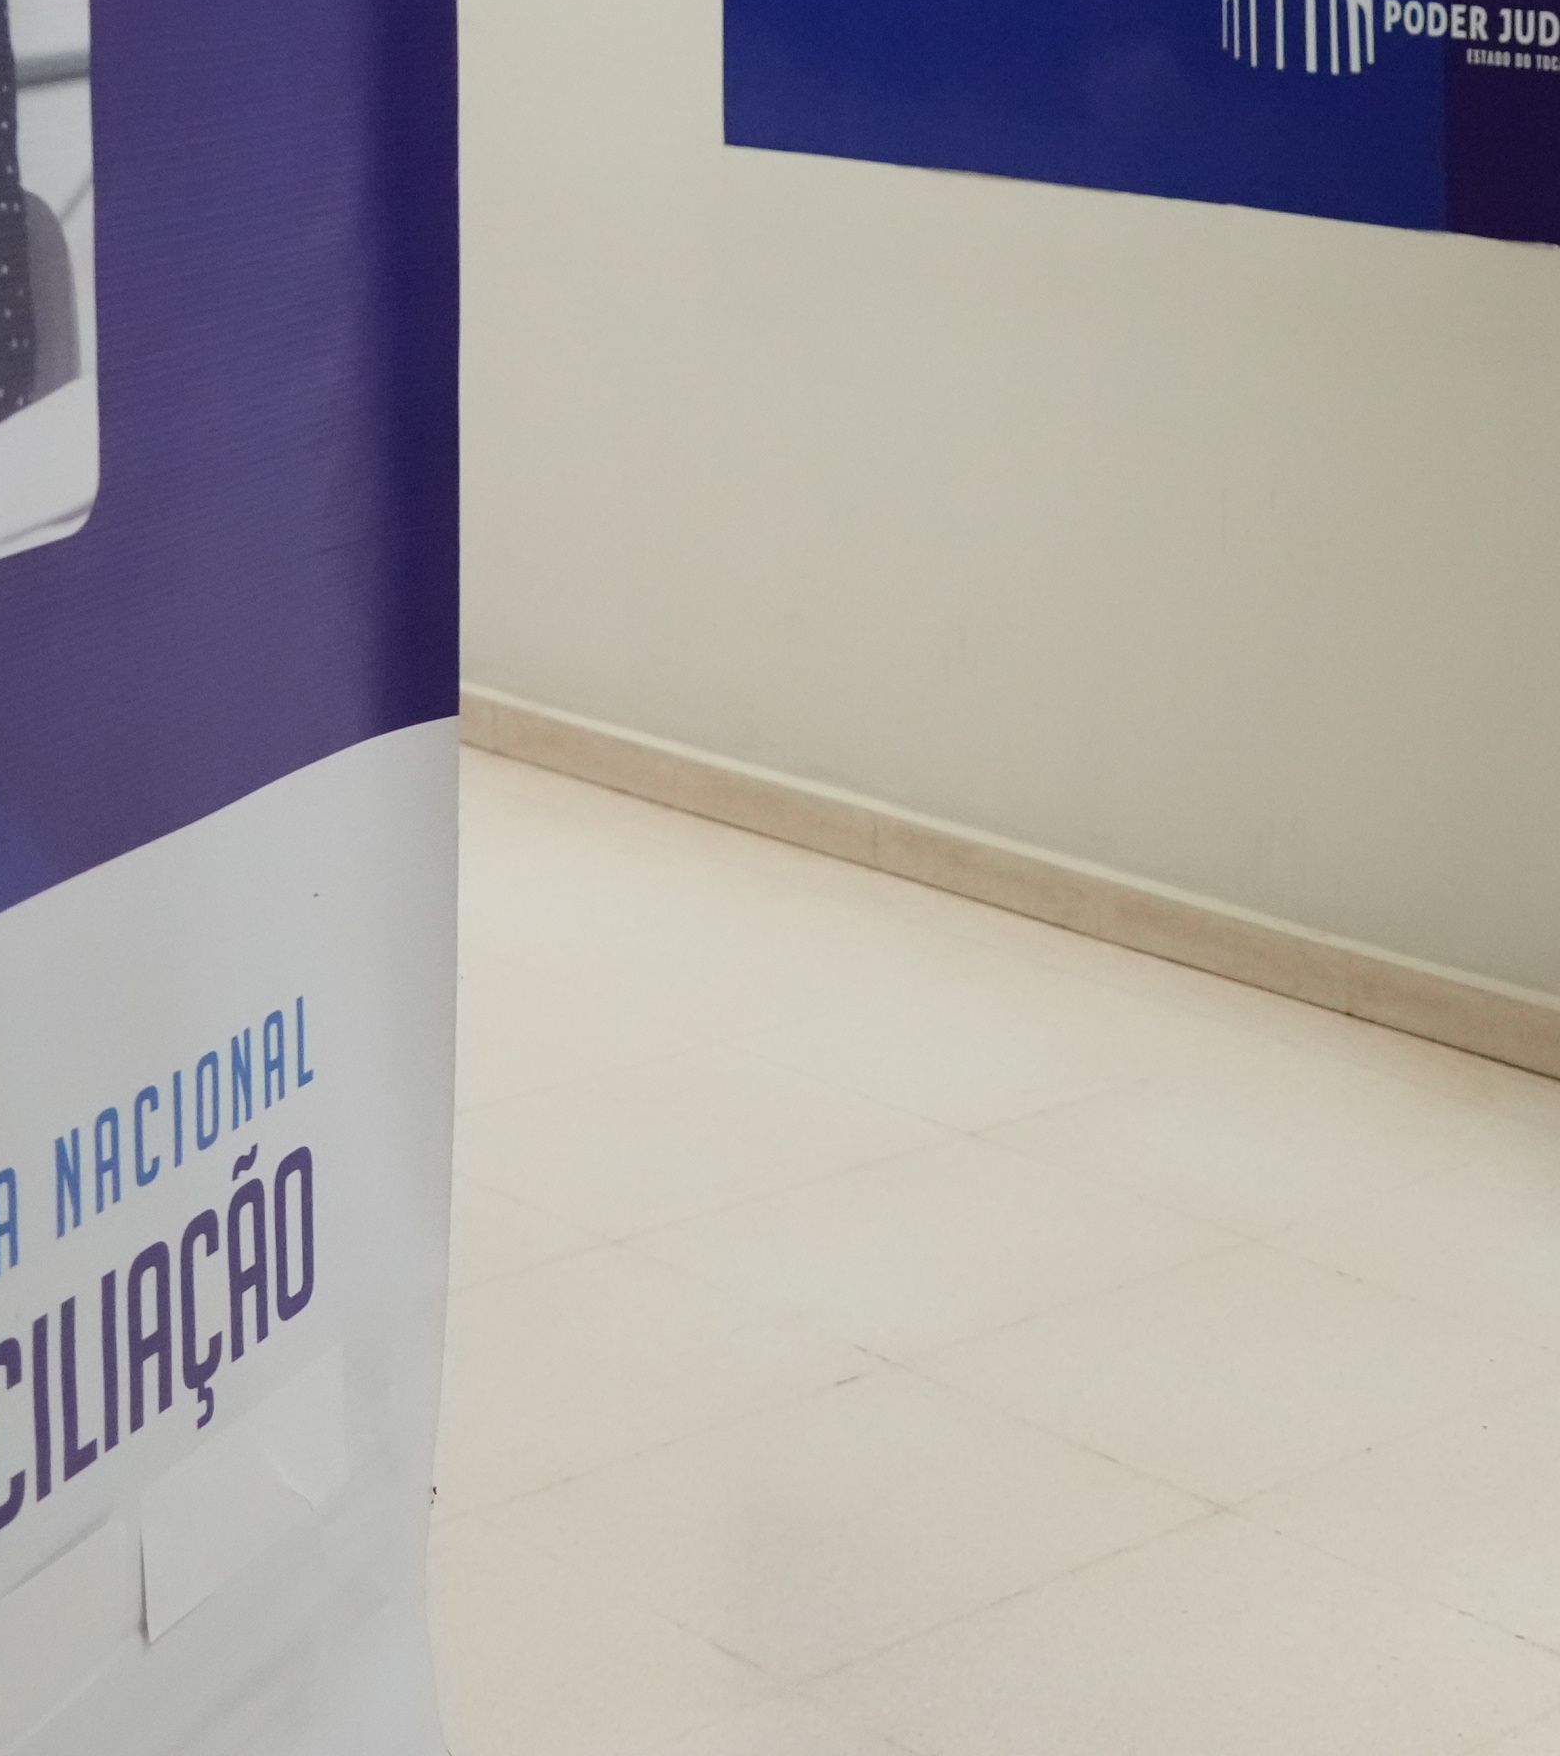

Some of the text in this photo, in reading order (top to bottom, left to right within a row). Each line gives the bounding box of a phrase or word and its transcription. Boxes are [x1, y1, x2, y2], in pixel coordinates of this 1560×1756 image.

[1466, 47, 1511, 68] ESTADO
[1514, 52, 1532, 69] DO
[54, 995, 314, 1239] NACIONAL
